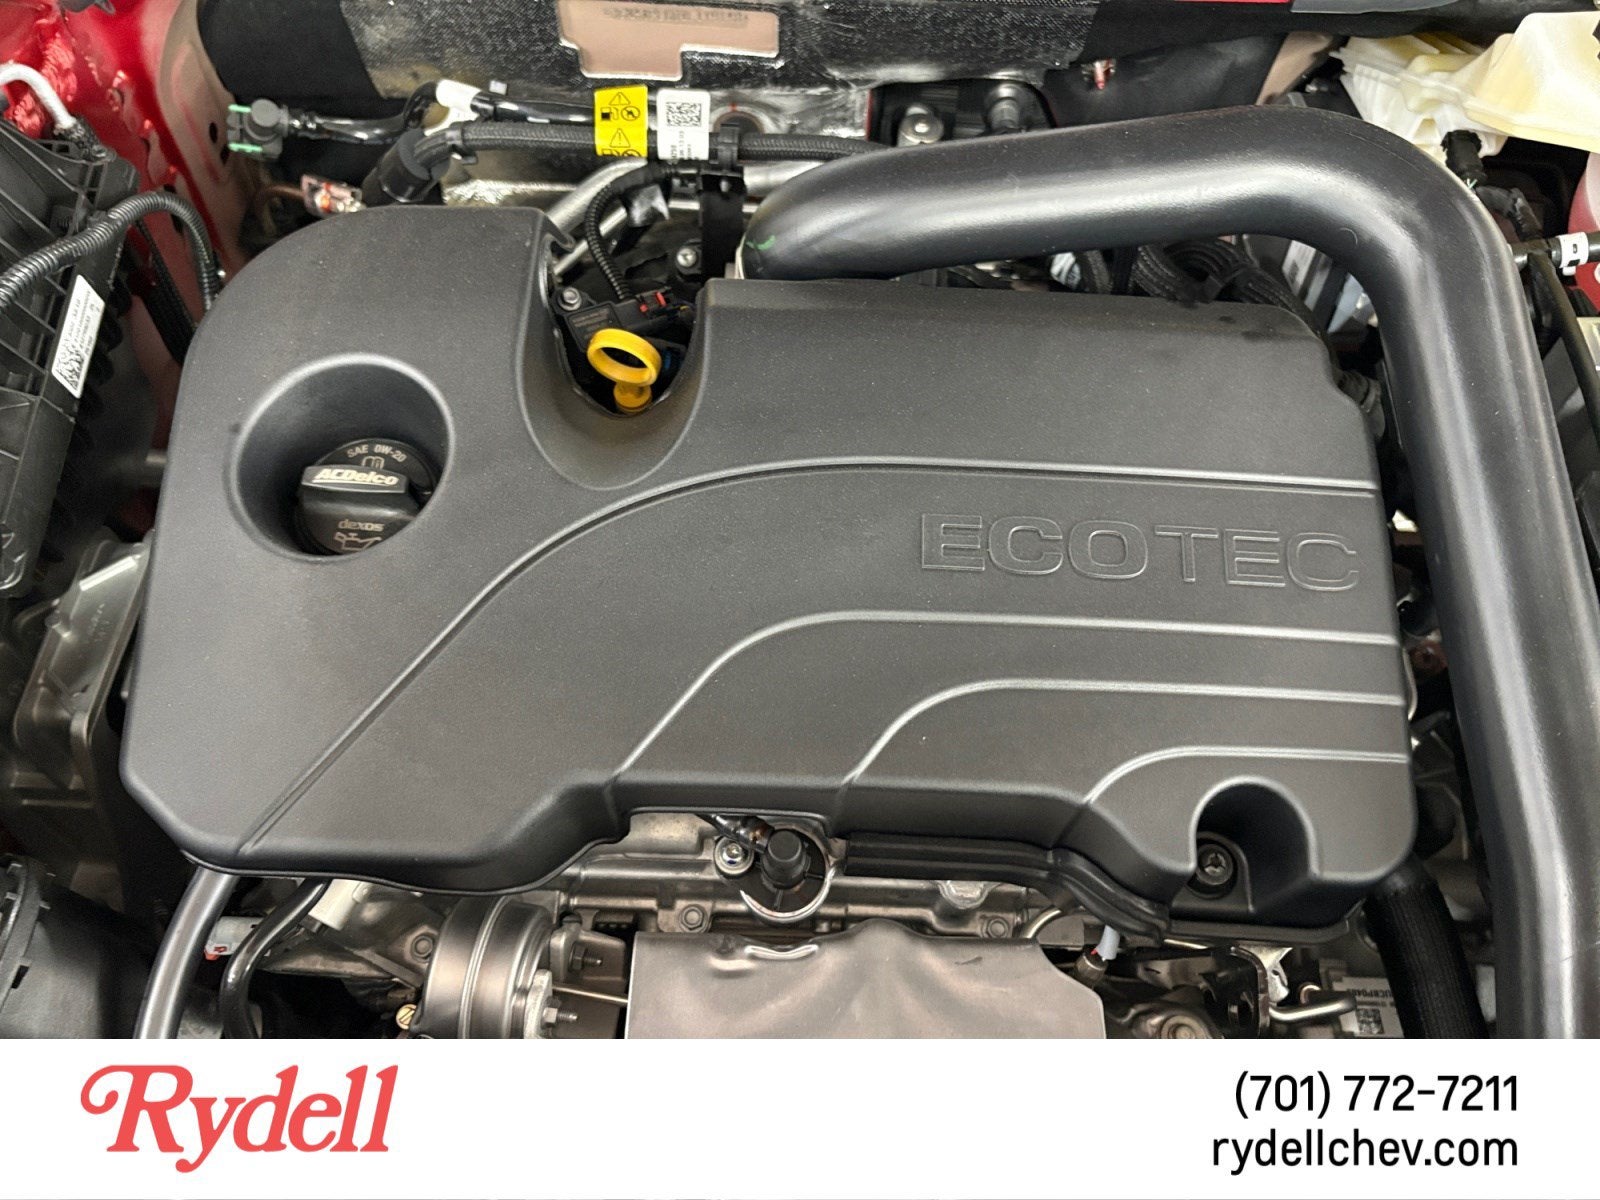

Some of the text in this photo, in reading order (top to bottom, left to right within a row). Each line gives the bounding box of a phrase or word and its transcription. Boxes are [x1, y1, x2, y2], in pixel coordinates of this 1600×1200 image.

[347, 444, 407, 462] SAE 0W-20
[313, 468, 399, 485] ACDelco
[338, 519, 385, 532] dexos
[921, 513, 1359, 591] ECOTEC
